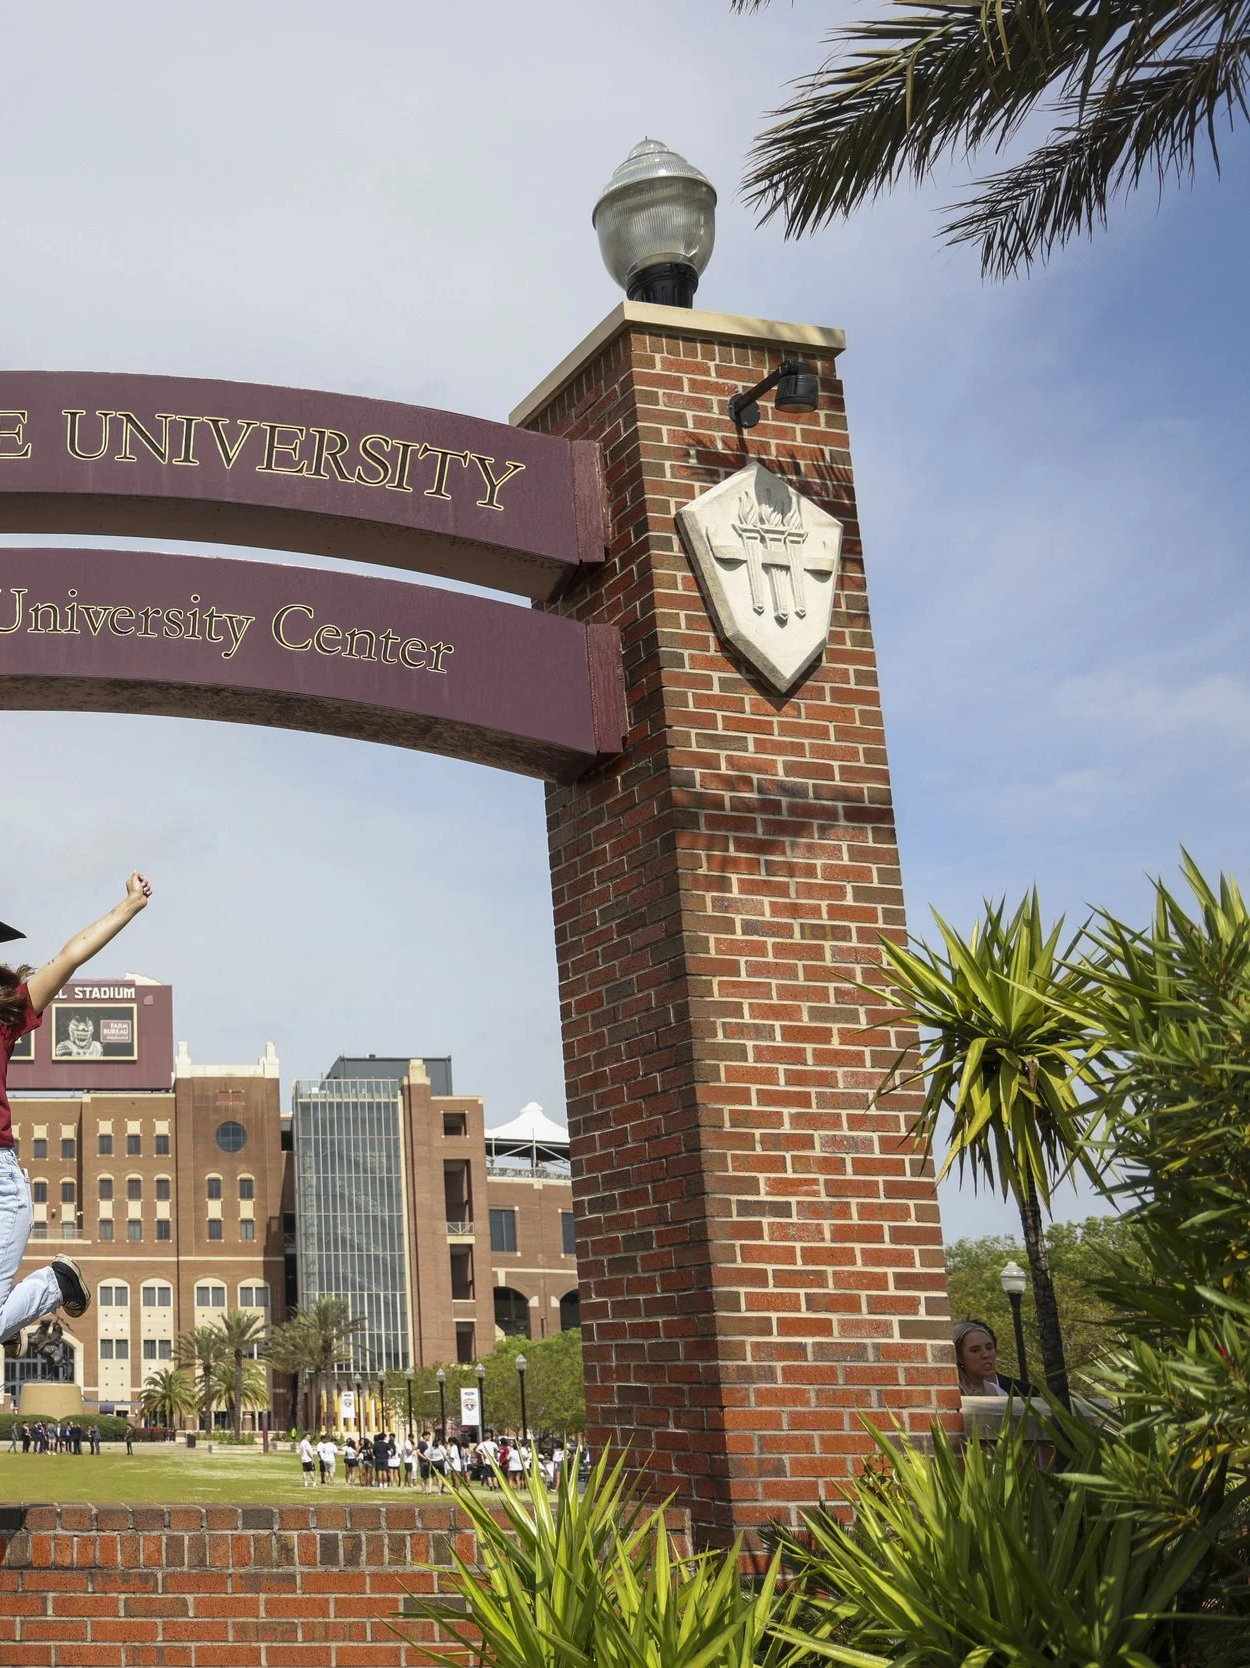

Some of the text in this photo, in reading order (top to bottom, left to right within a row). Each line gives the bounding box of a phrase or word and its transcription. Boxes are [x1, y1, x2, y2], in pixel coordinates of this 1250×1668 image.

[61, 409, 527, 512] UNIVERSITY
[271, 603, 455, 675] Center
[74, 986, 136, 999] STADIUM
